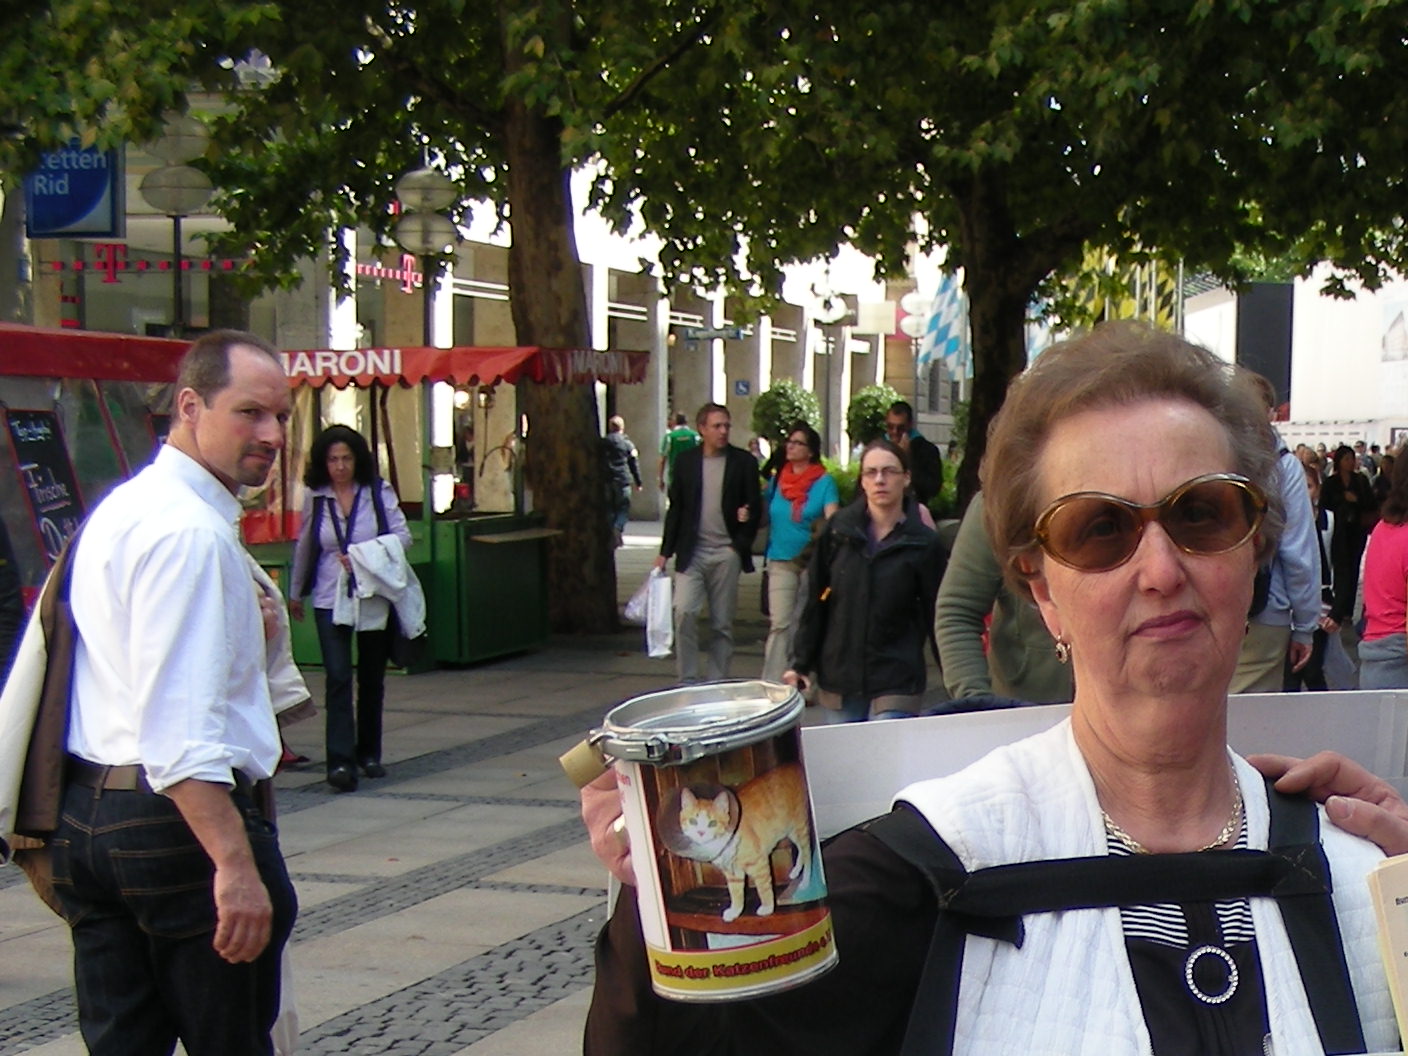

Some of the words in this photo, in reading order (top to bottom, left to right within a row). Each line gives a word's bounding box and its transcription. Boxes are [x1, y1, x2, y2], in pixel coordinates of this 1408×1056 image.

[42, 150, 107, 169] etten
[34, 173, 69, 195] Rid
[685, 966, 710, 979] der
[712, 941, 820, 977] Katzenfreunde
